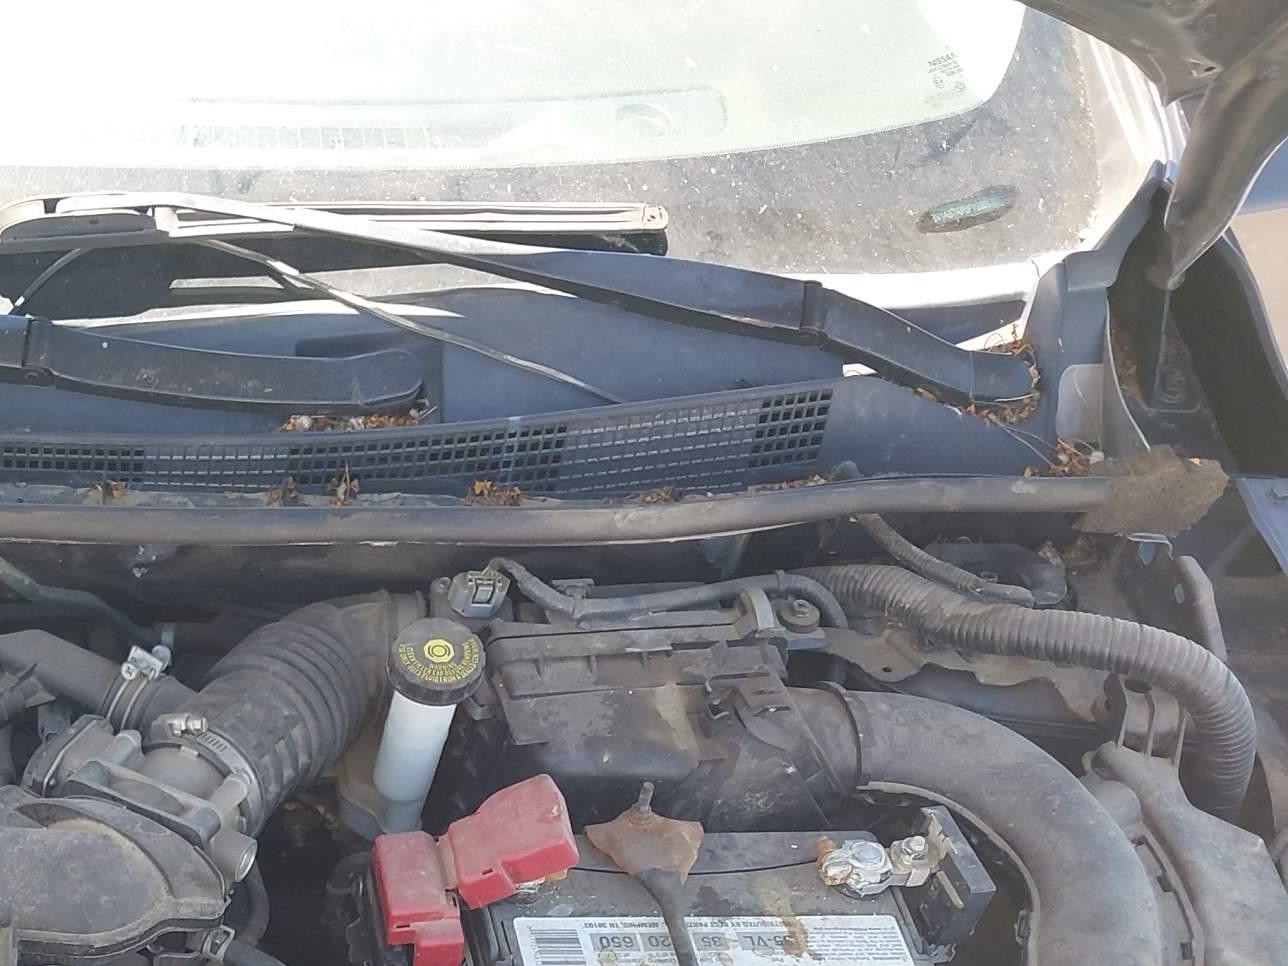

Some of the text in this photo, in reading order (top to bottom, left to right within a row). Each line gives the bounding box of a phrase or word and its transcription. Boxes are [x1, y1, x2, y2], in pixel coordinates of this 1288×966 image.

[599, 936, 634, 949] 650
[647, 936, 671, 948] 20
[701, 936, 721, 947] 35
